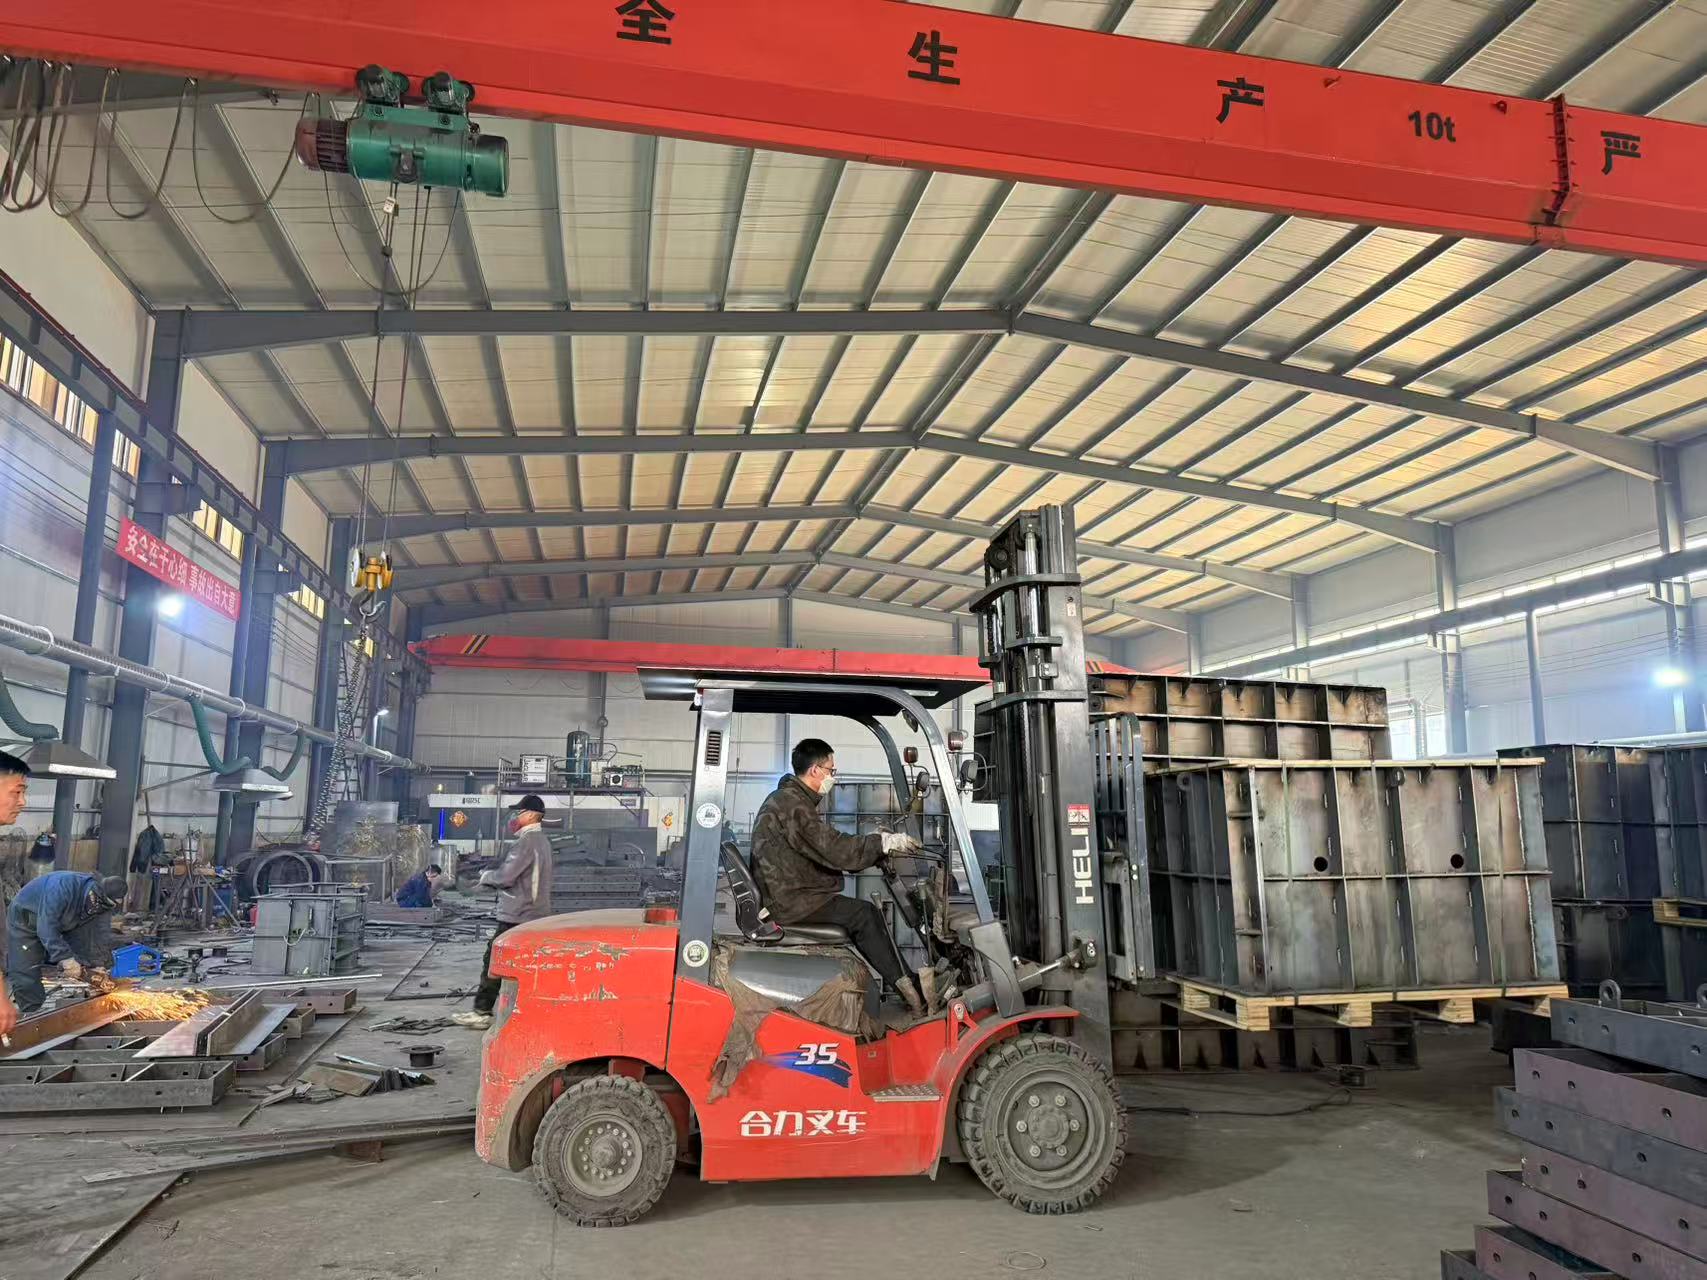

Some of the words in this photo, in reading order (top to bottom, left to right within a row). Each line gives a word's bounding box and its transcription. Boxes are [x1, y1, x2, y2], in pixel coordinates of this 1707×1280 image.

[615, 0, 676, 45] 全
[907, 29, 961, 86] 生
[1215, 76, 1265, 124] 产
[1600, 129, 1642, 176] 严
[1407, 110, 1457, 143] 10t
[1070, 827, 1095, 904] HELI
[794, 1042, 840, 1066] 35
[738, 1109, 868, 1138] 合力叉车
